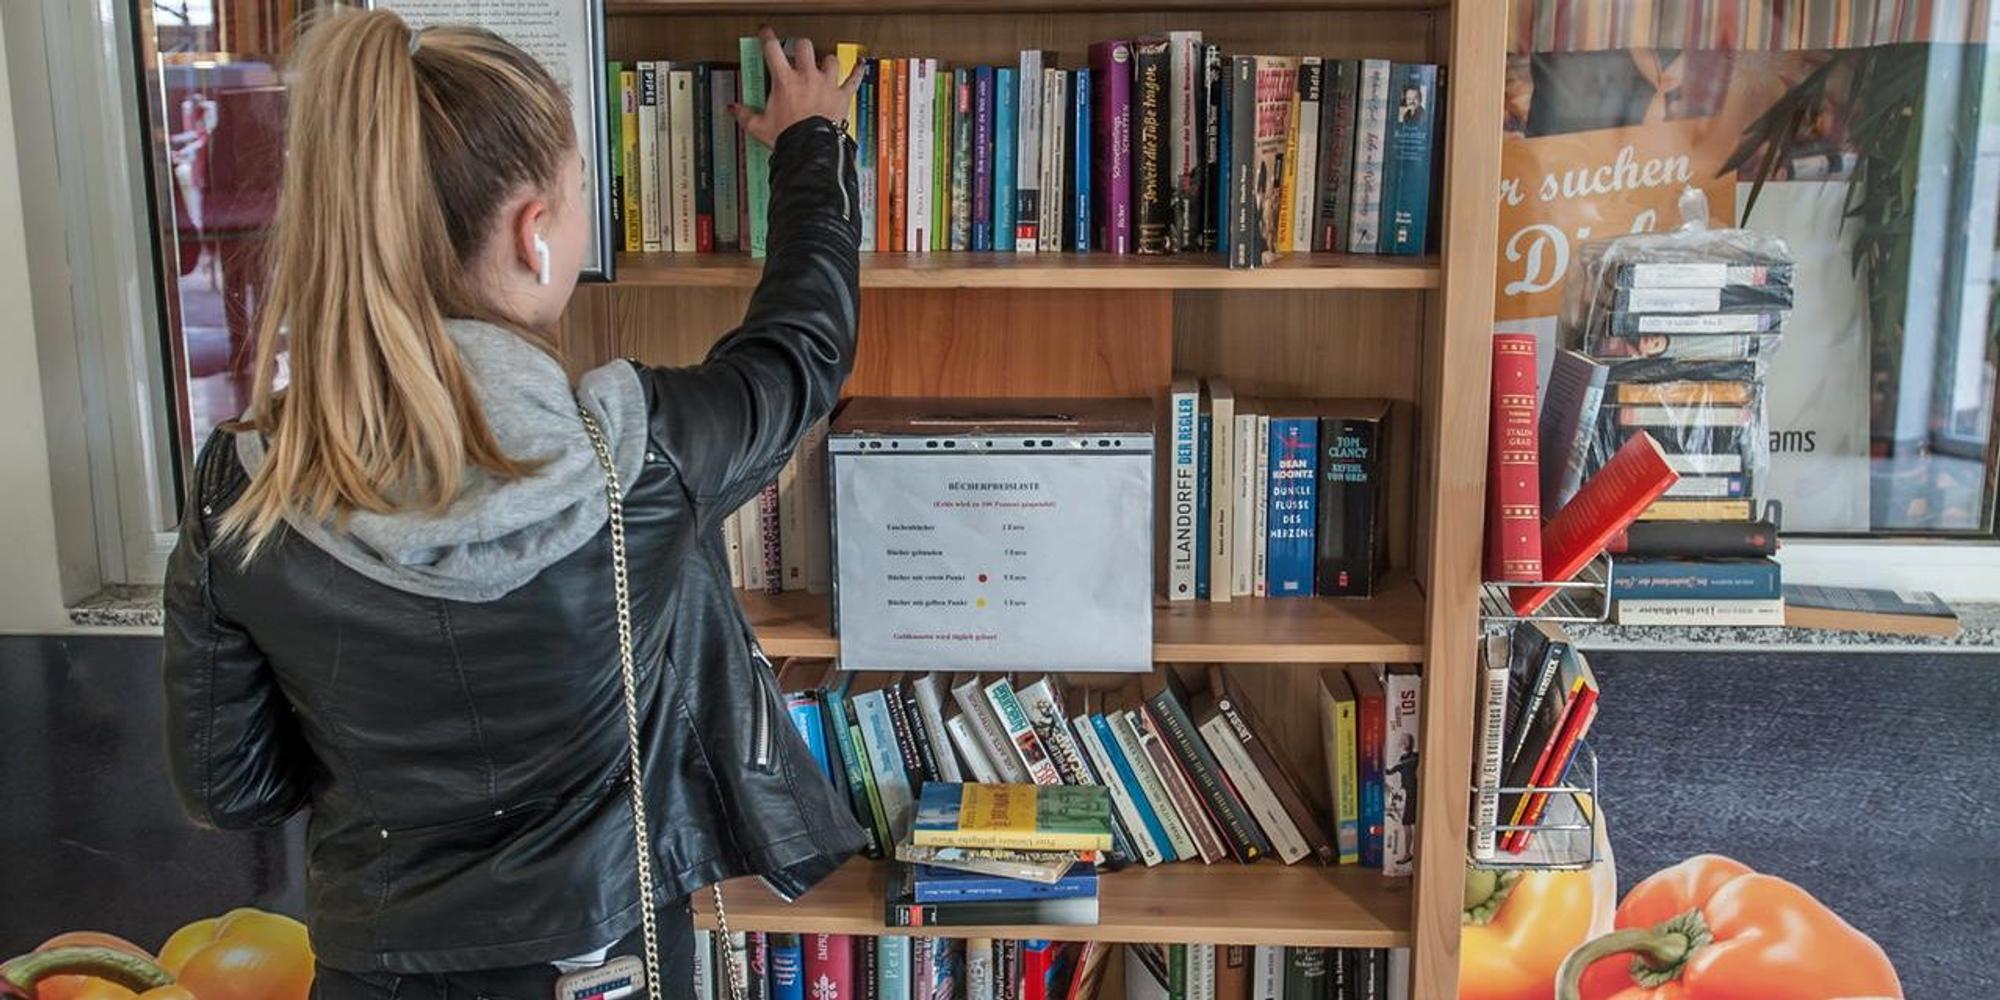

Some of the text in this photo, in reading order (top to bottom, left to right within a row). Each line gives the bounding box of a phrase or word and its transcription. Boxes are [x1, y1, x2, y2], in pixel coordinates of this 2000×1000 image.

[645, 72, 654, 105] PIPER
[1309, 66, 1321, 100] PIPER
[1539, 144, 1694, 203] suchen
[1178, 398, 1193, 465] DER REGLER
[1336, 436, 1360, 447] TOM
[1328, 447, 1368, 458] CLANCY
[1279, 459, 1307, 468] DEAN
[1272, 469, 1314, 479] KOONTZ
[948, 481, 1040, 491] BÜCHERPREISLISTE
[1273, 487, 1310, 496] DUNKLE
[1275, 499, 1309, 510] FLÜSSE
[1176, 468, 1191, 562] LANDORFF
[1283, 515, 1301, 524] DES
[1271, 528, 1313, 539] HERZENS
[888, 573, 910, 582] Bücher
[888, 598, 911, 607] Bücher
[1489, 678, 1504, 707] Profil
